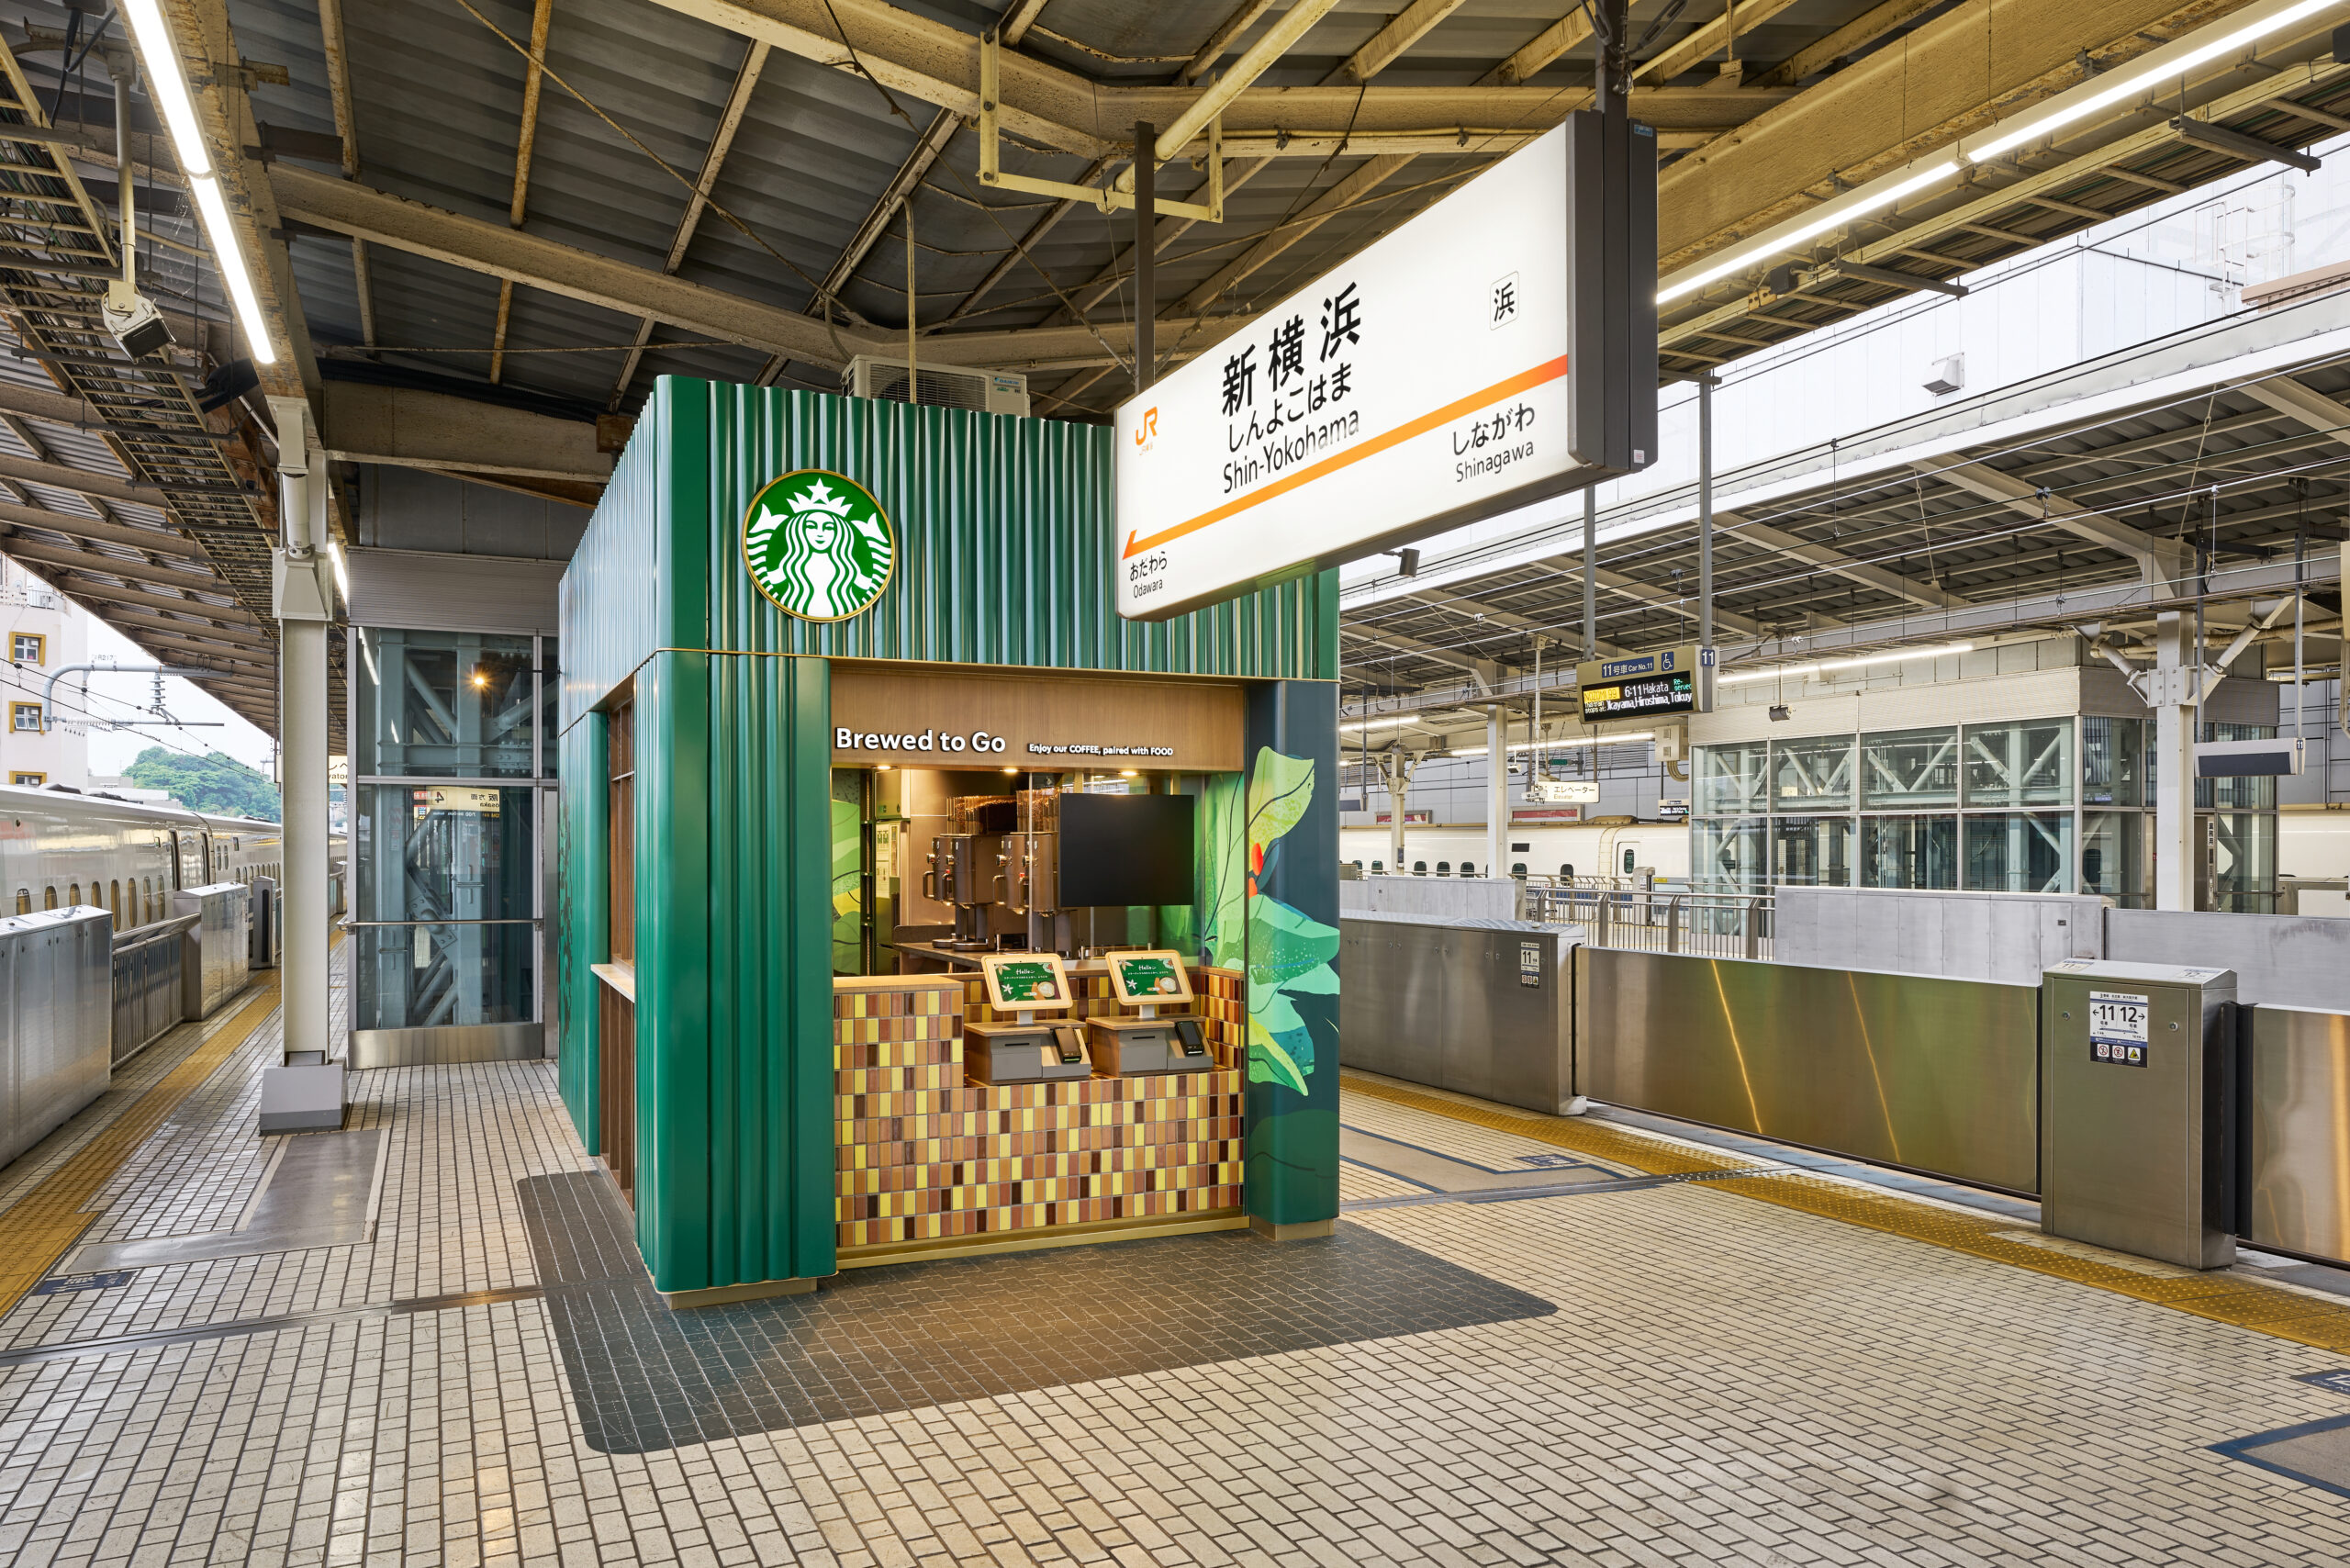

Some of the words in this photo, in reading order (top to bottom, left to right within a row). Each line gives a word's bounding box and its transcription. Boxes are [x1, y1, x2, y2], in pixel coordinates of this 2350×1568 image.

[1494, 282, 1515, 321] 浜
[1222, 281, 1361, 417] 新横浜
[1229, 362, 1352, 453] しんよこはま
[1136, 406, 1158, 446] JR
[1453, 403, 1535, 456] しながわ
[1223, 409, 1360, 494] Shin-Yokohama
[1456, 441, 1534, 483] Shinagawa
[1130, 551, 1167, 581] おだわら
[1134, 578, 1163, 599] Odawara
[1703, 651, 1714, 665] 11
[1584, 691, 1606, 701] NOZOMI
[1624, 685, 1642, 698] 6:11
[1643, 682, 1669, 695] Hakata
[836, 727, 933, 751] Brewed
[940, 732, 966, 752] to
[971, 731, 1006, 753] Go
[1029, 744, 1051, 754] Enjoy
[1069, 745, 1102, 755] COFFEE,
[1102, 745, 1129, 755] paired
[1131, 746, 1149, 755] with
[1150, 747, 1174, 756] FOOD
[1554, 786, 1595, 794] エレベーター
[1522, 950, 1531, 964] 11
[2099, 1004, 2114, 1021] 11
[2120, 1006, 2138, 1023] 12
